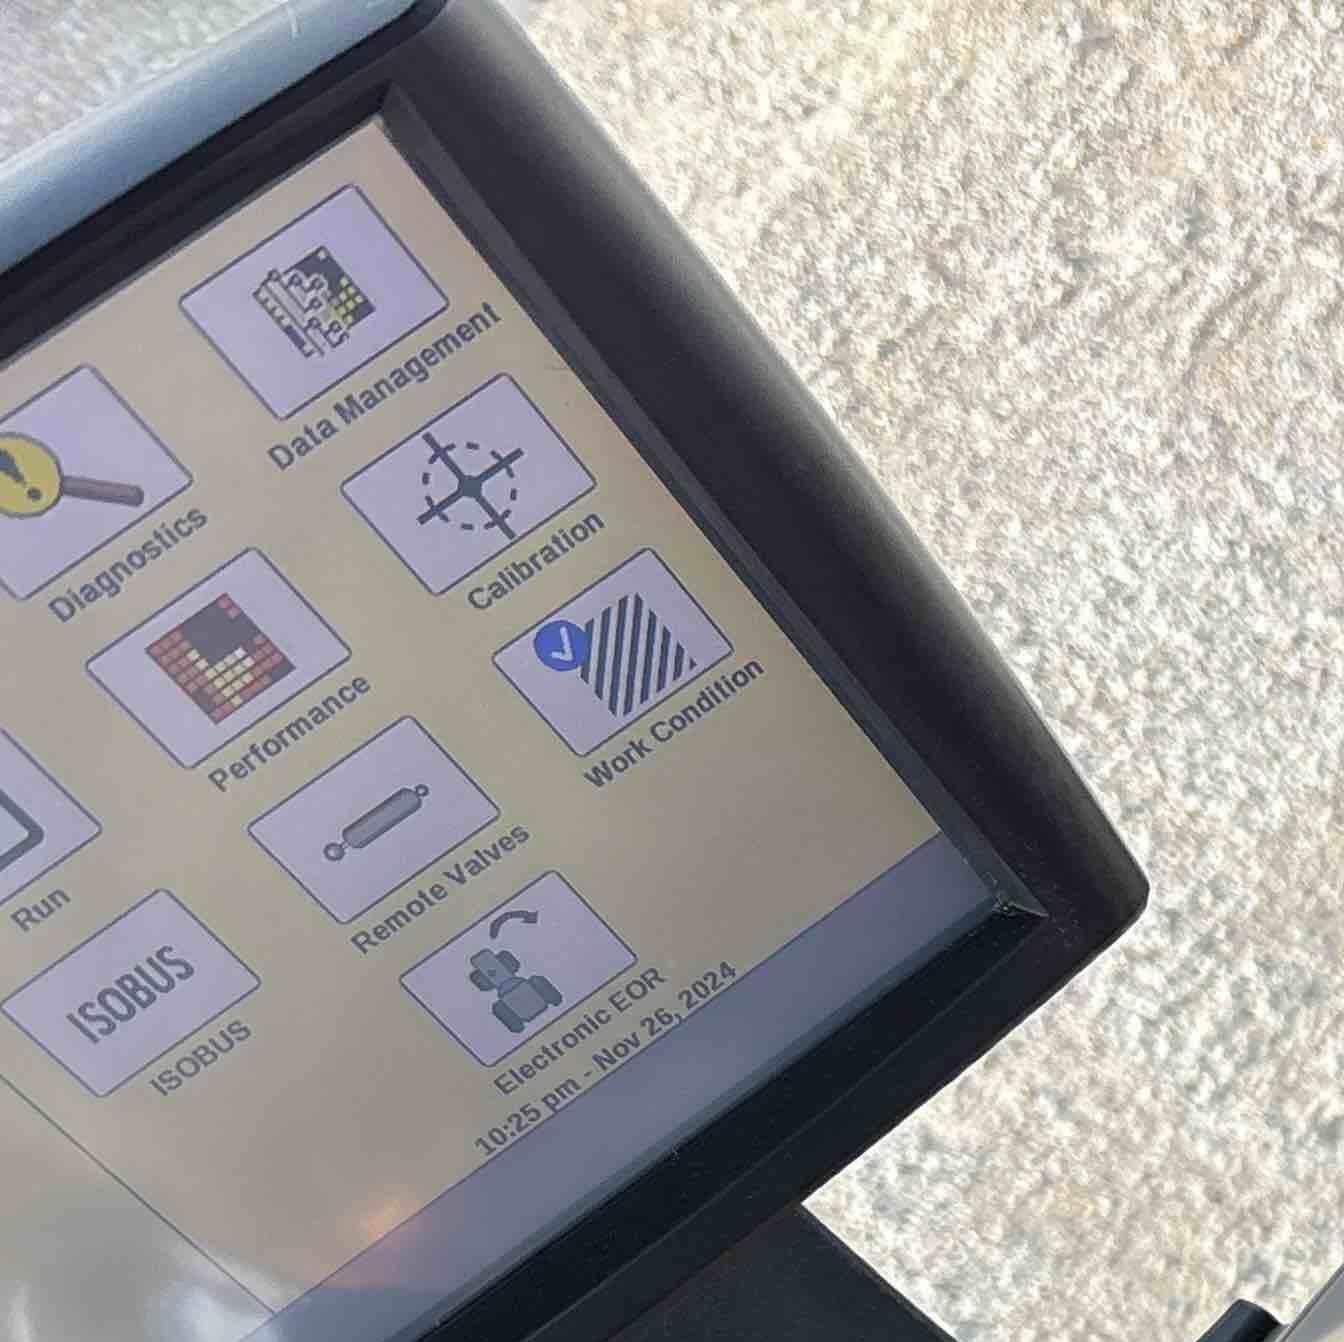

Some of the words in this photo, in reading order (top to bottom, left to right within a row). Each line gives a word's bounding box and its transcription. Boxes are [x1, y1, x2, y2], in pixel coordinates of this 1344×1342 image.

[266, 422, 338, 473] Data
[332, 304, 502, 425] Management
[48, 505, 208, 624] Diagnostics
[467, 510, 606, 612] Calibration
[207, 671, 371, 793] Performance
[583, 727, 660, 790] Work
[645, 656, 765, 746] Condition
[10, 885, 71, 933] Run
[349, 878, 447, 957] Remote
[443, 823, 529, 897] Valves
[65, 942, 195, 1045] ISOBUS
[493, 1004, 613, 1098] Electronic
[609, 966, 666, 1020] EOR
[149, 1020, 252, 1098] ISOBUS
[474, 1104, 539, 1157] 10:25
[534, 1073, 581, 1119] pm
[592, 1025, 644, 1073] Nov
[636, 997, 684, 1050] 26,
[677, 961, 738, 1018] 2024
